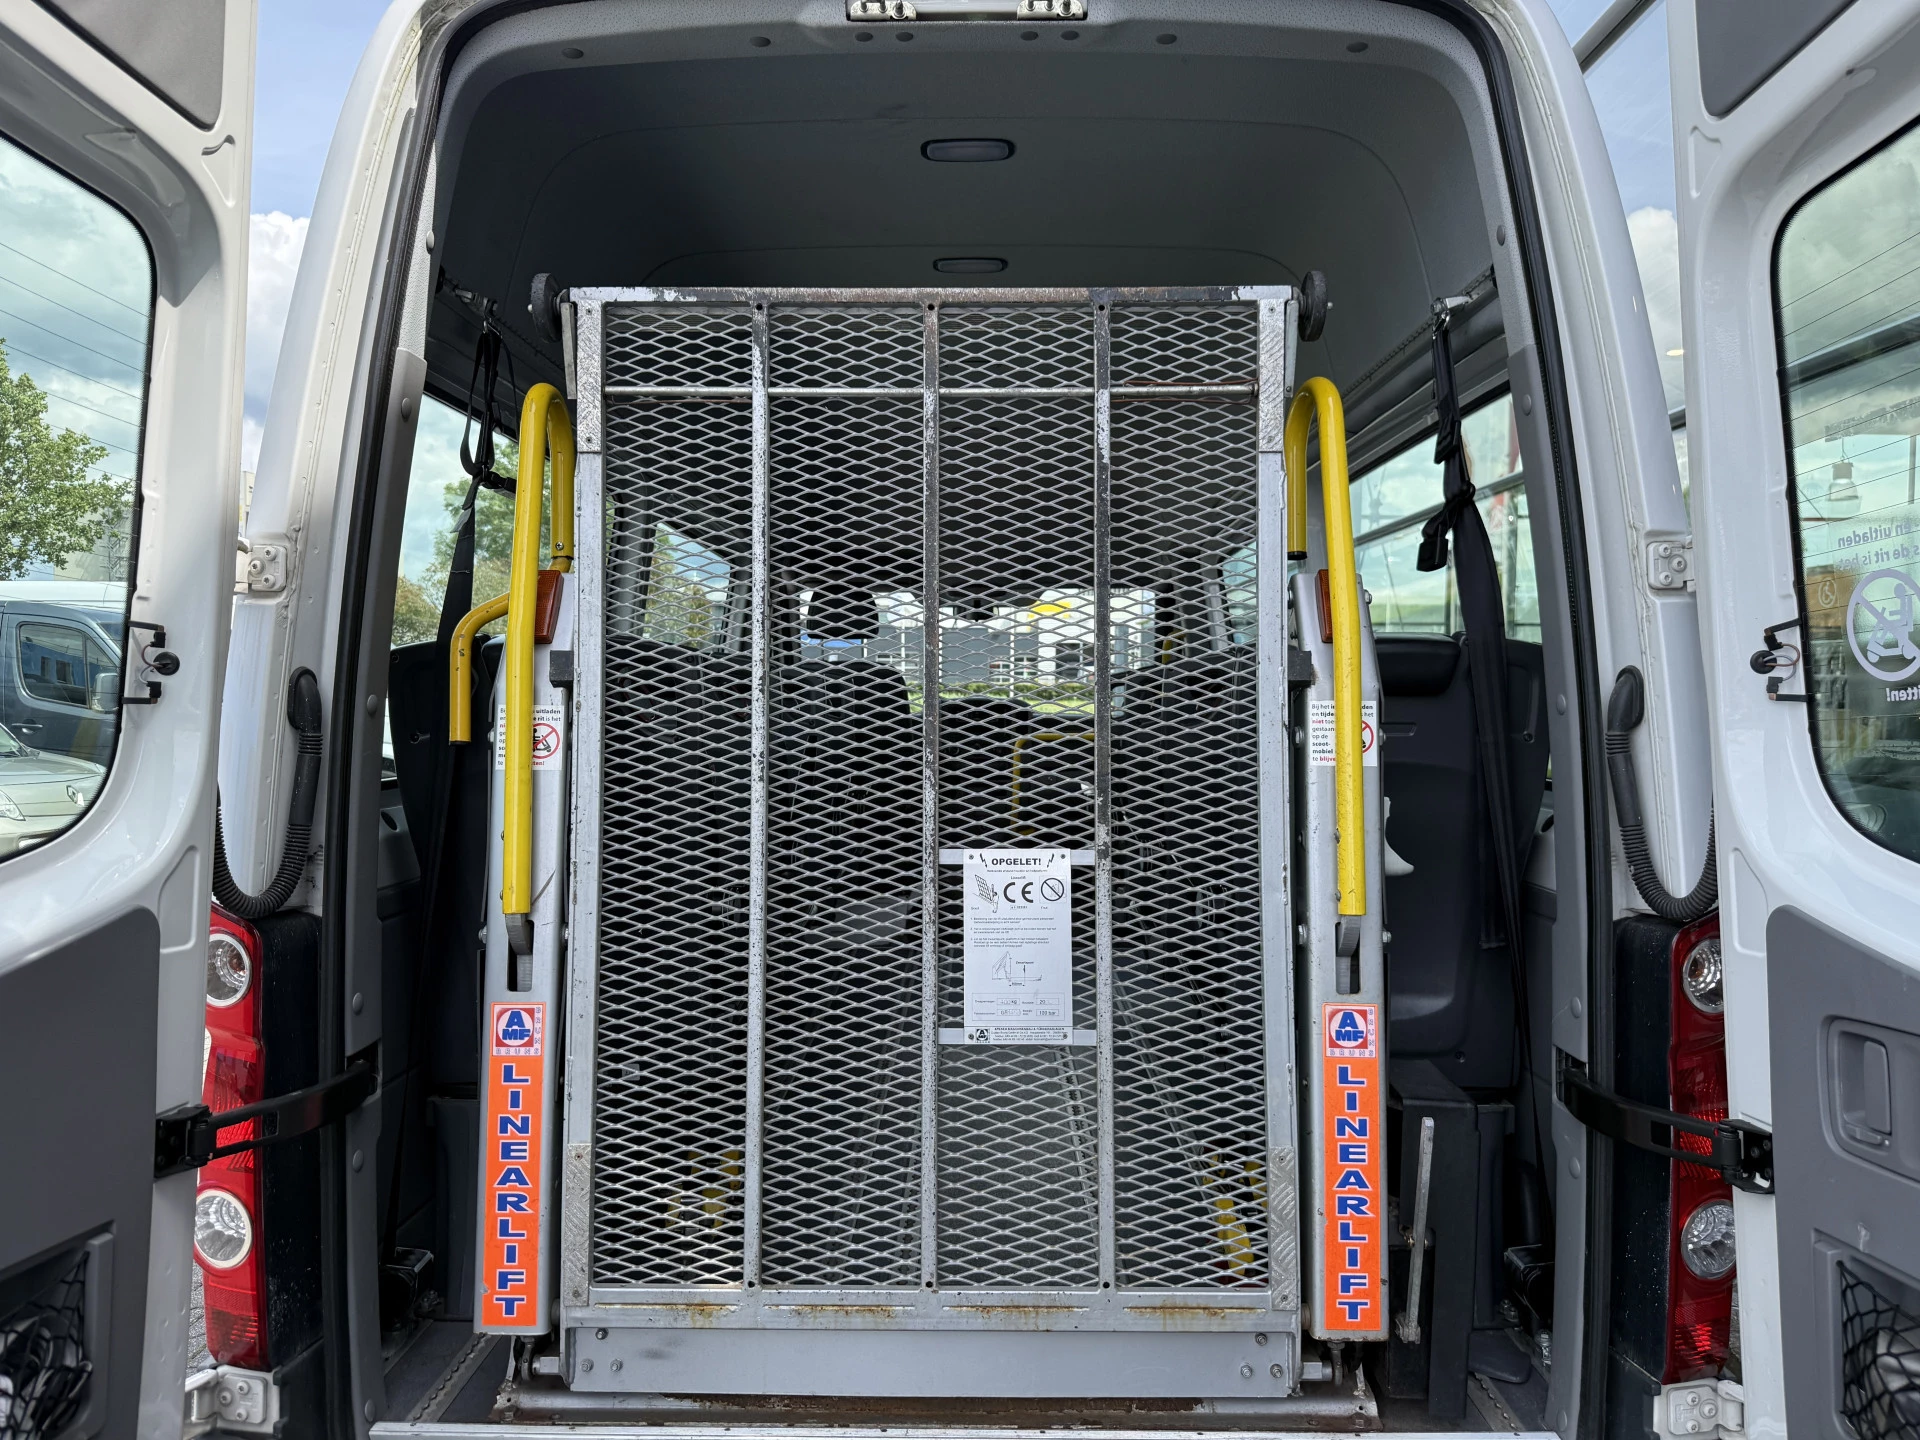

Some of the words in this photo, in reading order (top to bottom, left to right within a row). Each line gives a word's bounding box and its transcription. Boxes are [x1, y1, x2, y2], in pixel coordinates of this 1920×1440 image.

[991, 858, 1042, 866] OPGELET!
[1003, 882, 1034, 904] CE
[494, 1063, 534, 1317] LINEARLIFT
[1333, 1064, 1375, 1321] LINEARLIFT
